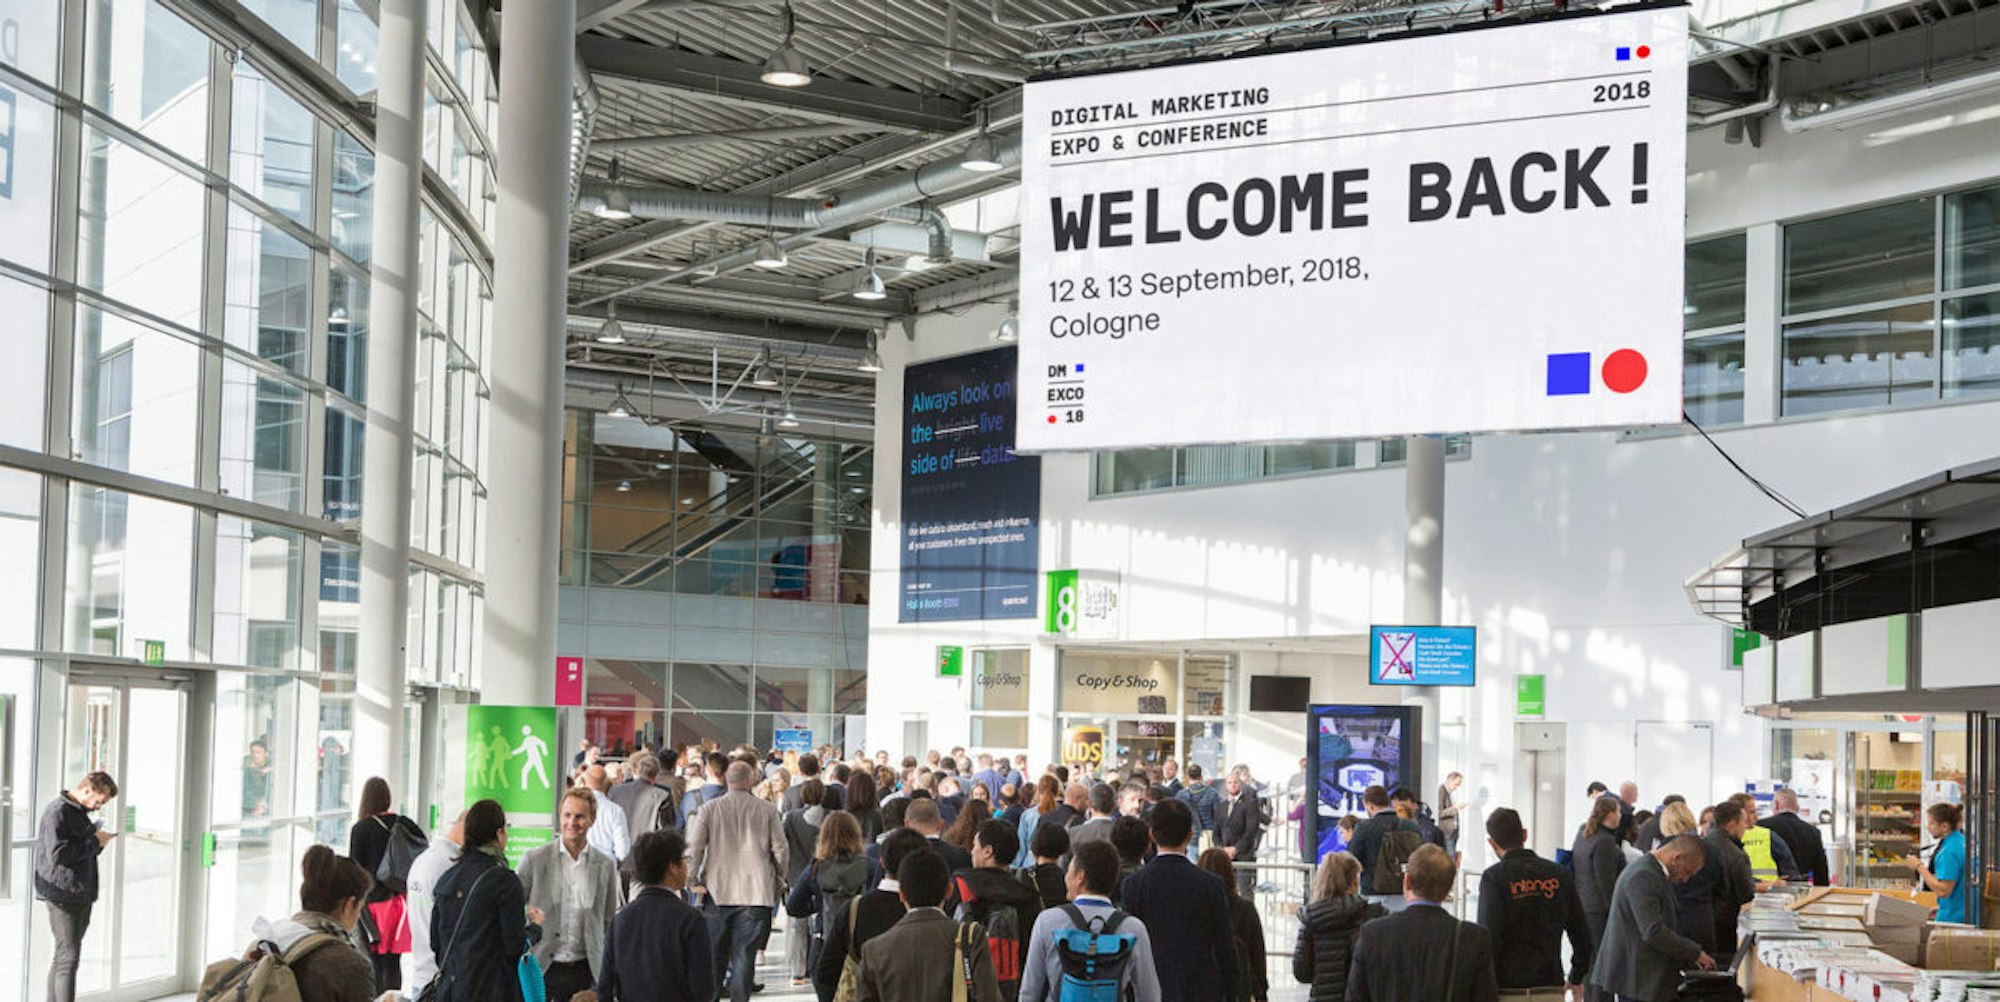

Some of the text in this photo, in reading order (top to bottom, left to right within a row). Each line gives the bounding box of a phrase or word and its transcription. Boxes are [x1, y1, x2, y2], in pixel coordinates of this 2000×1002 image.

[1593, 80, 1651, 103] 2018
[1051, 87, 1269, 127] DIGITAL MARKETING
[1051, 118, 1269, 157] EXPO & CONFERENCE
[1050, 141, 1649, 253] WELCOME BACK!
[1049, 256, 1369, 303] 12 & 13 September, 2018,
[1049, 311, 1161, 340] Cologne
[1048, 364, 1067, 378] DM
[911, 381, 1011, 413] Always look on
[1047, 387, 1084, 402] EXCO
[911, 422, 933, 444] the
[980, 412, 1004, 433] live
[1066, 409, 1084, 423] 18
[911, 452, 938, 475] side
[940, 448, 955, 470] of
[1056, 586, 1076, 633] 8
[977, 673, 1022, 689] Copy & Shop
[1077, 673, 1159, 690] Copy & Shop
